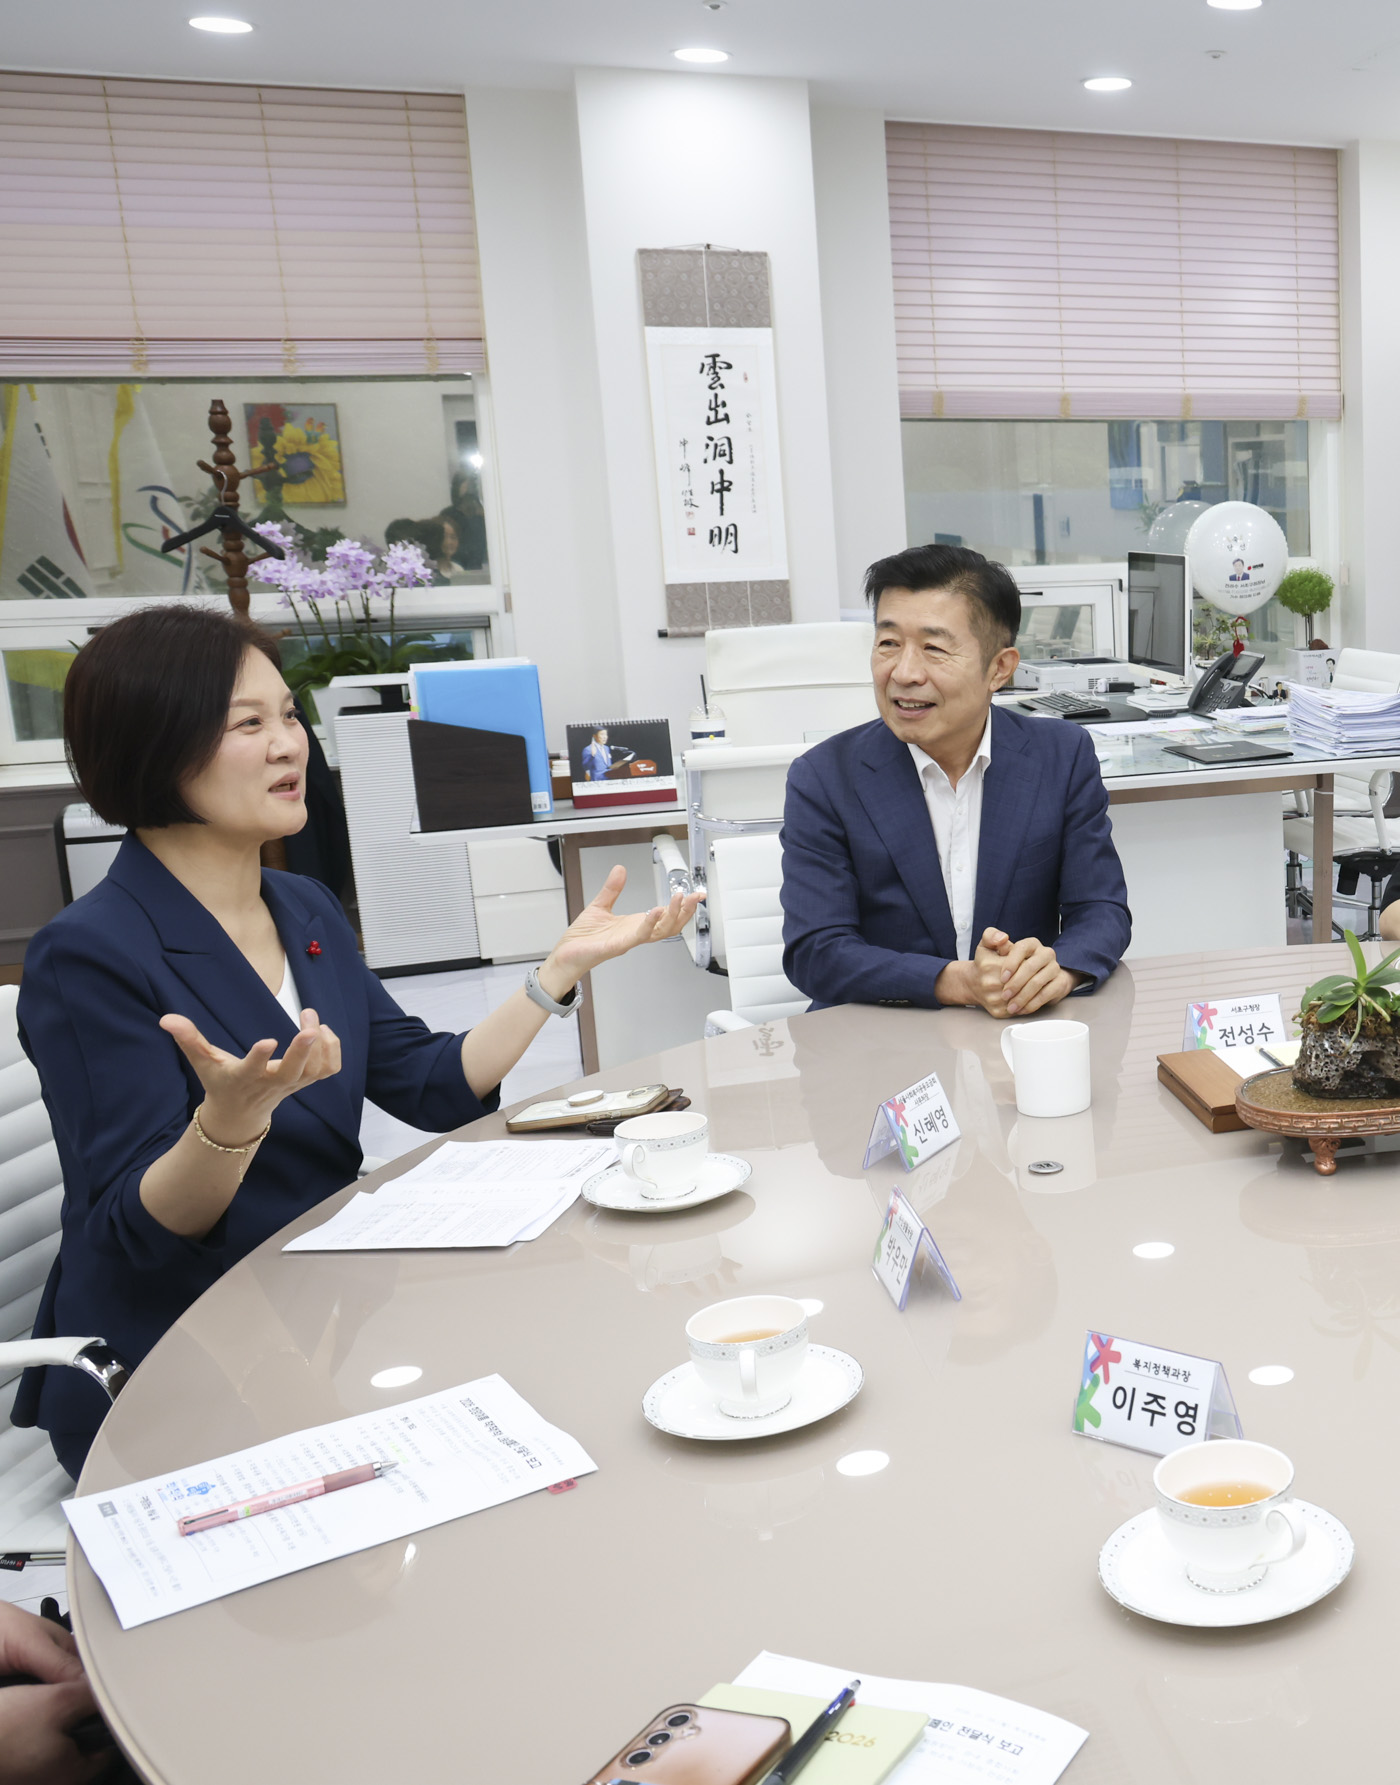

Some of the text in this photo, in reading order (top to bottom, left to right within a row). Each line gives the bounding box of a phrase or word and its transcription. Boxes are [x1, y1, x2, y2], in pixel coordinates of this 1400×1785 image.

[699, 354, 739, 554] 雲出洞中明
[1231, 1003, 1261, 1014] 서초구청장
[1218, 1022, 1275, 1047] 전성수
[913, 1105, 949, 1144] 신혜영
[1132, 1358, 1191, 1383] 복지정책과장
[1112, 1385, 1199, 1437] 이주영
[525, 1456, 542, 1469] 보고
[823, 1730, 877, 1748] 2026
[956, 1725, 995, 1745] 전달식
[996, 1739, 1024, 1756] 보고
